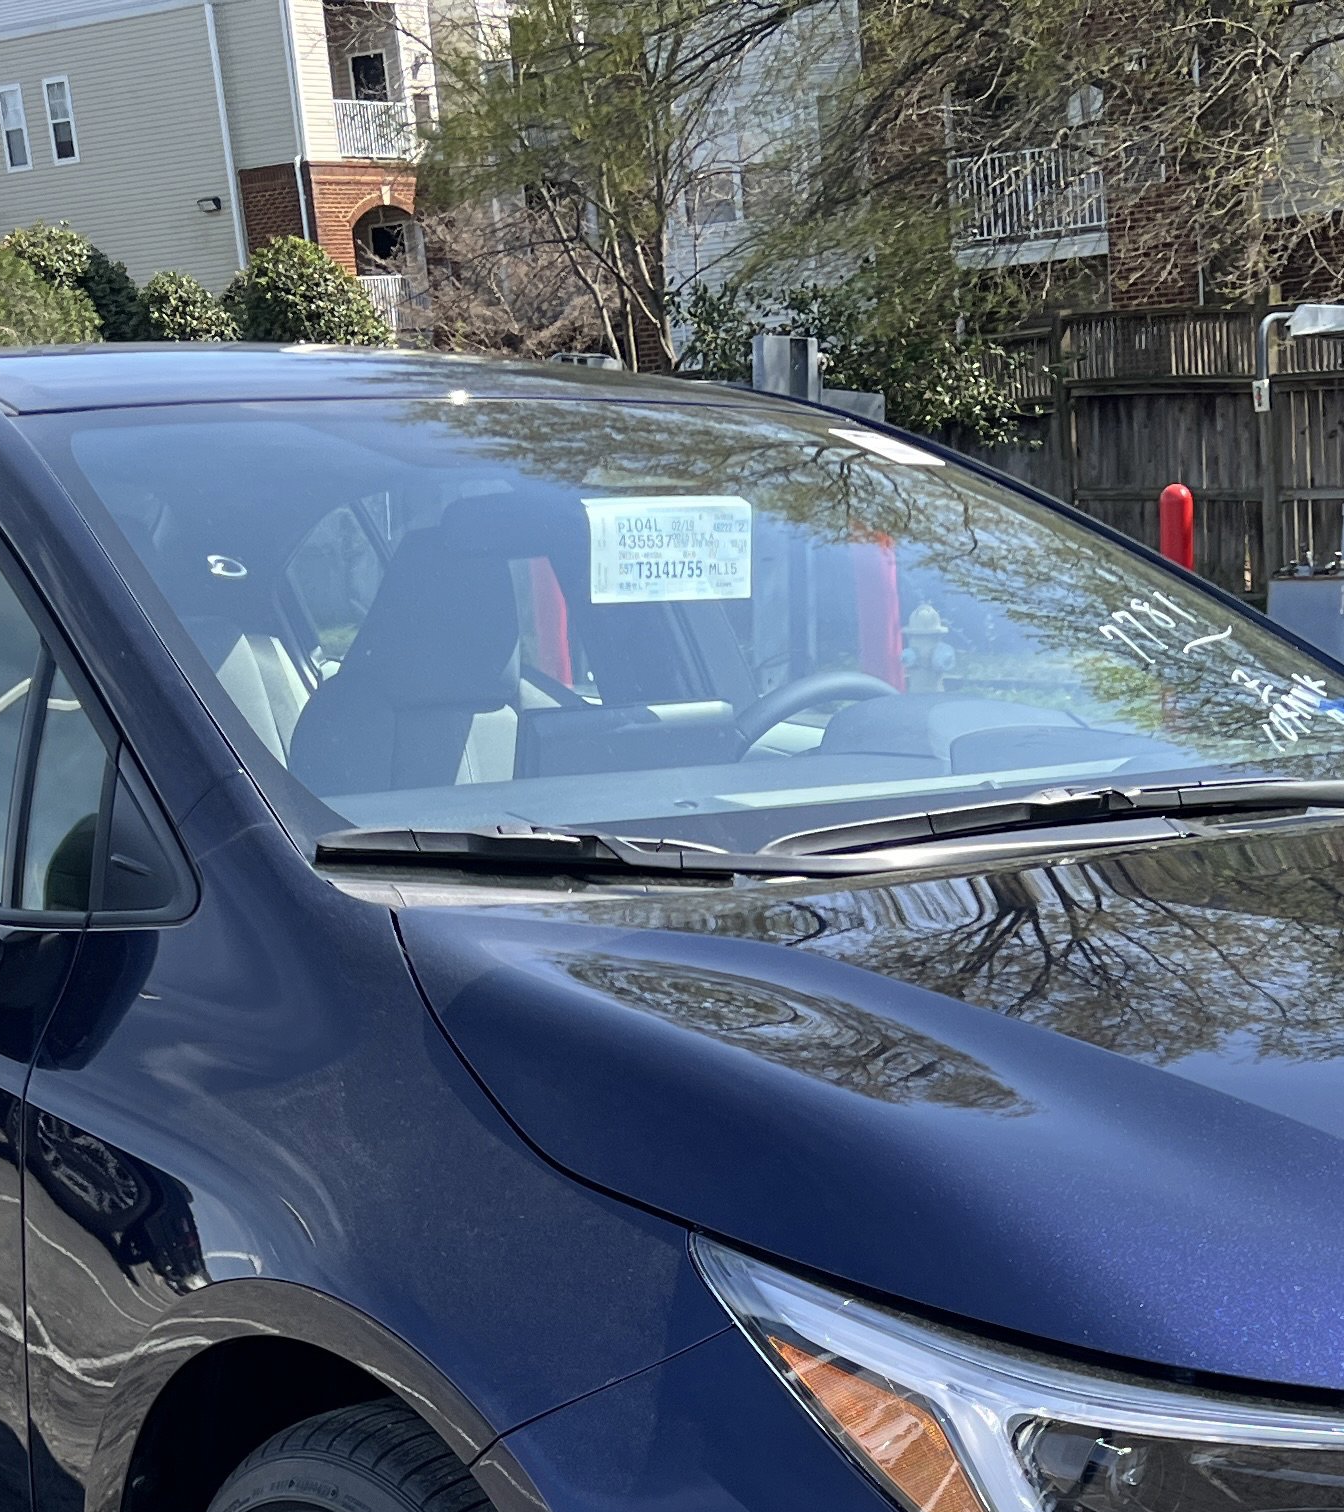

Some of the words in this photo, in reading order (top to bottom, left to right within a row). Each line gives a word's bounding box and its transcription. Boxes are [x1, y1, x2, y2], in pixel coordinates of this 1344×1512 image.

[618, 534, 673, 549] 435537
[636, 560, 703, 579] T3141755
[1099, 591, 1197, 664] 7781
